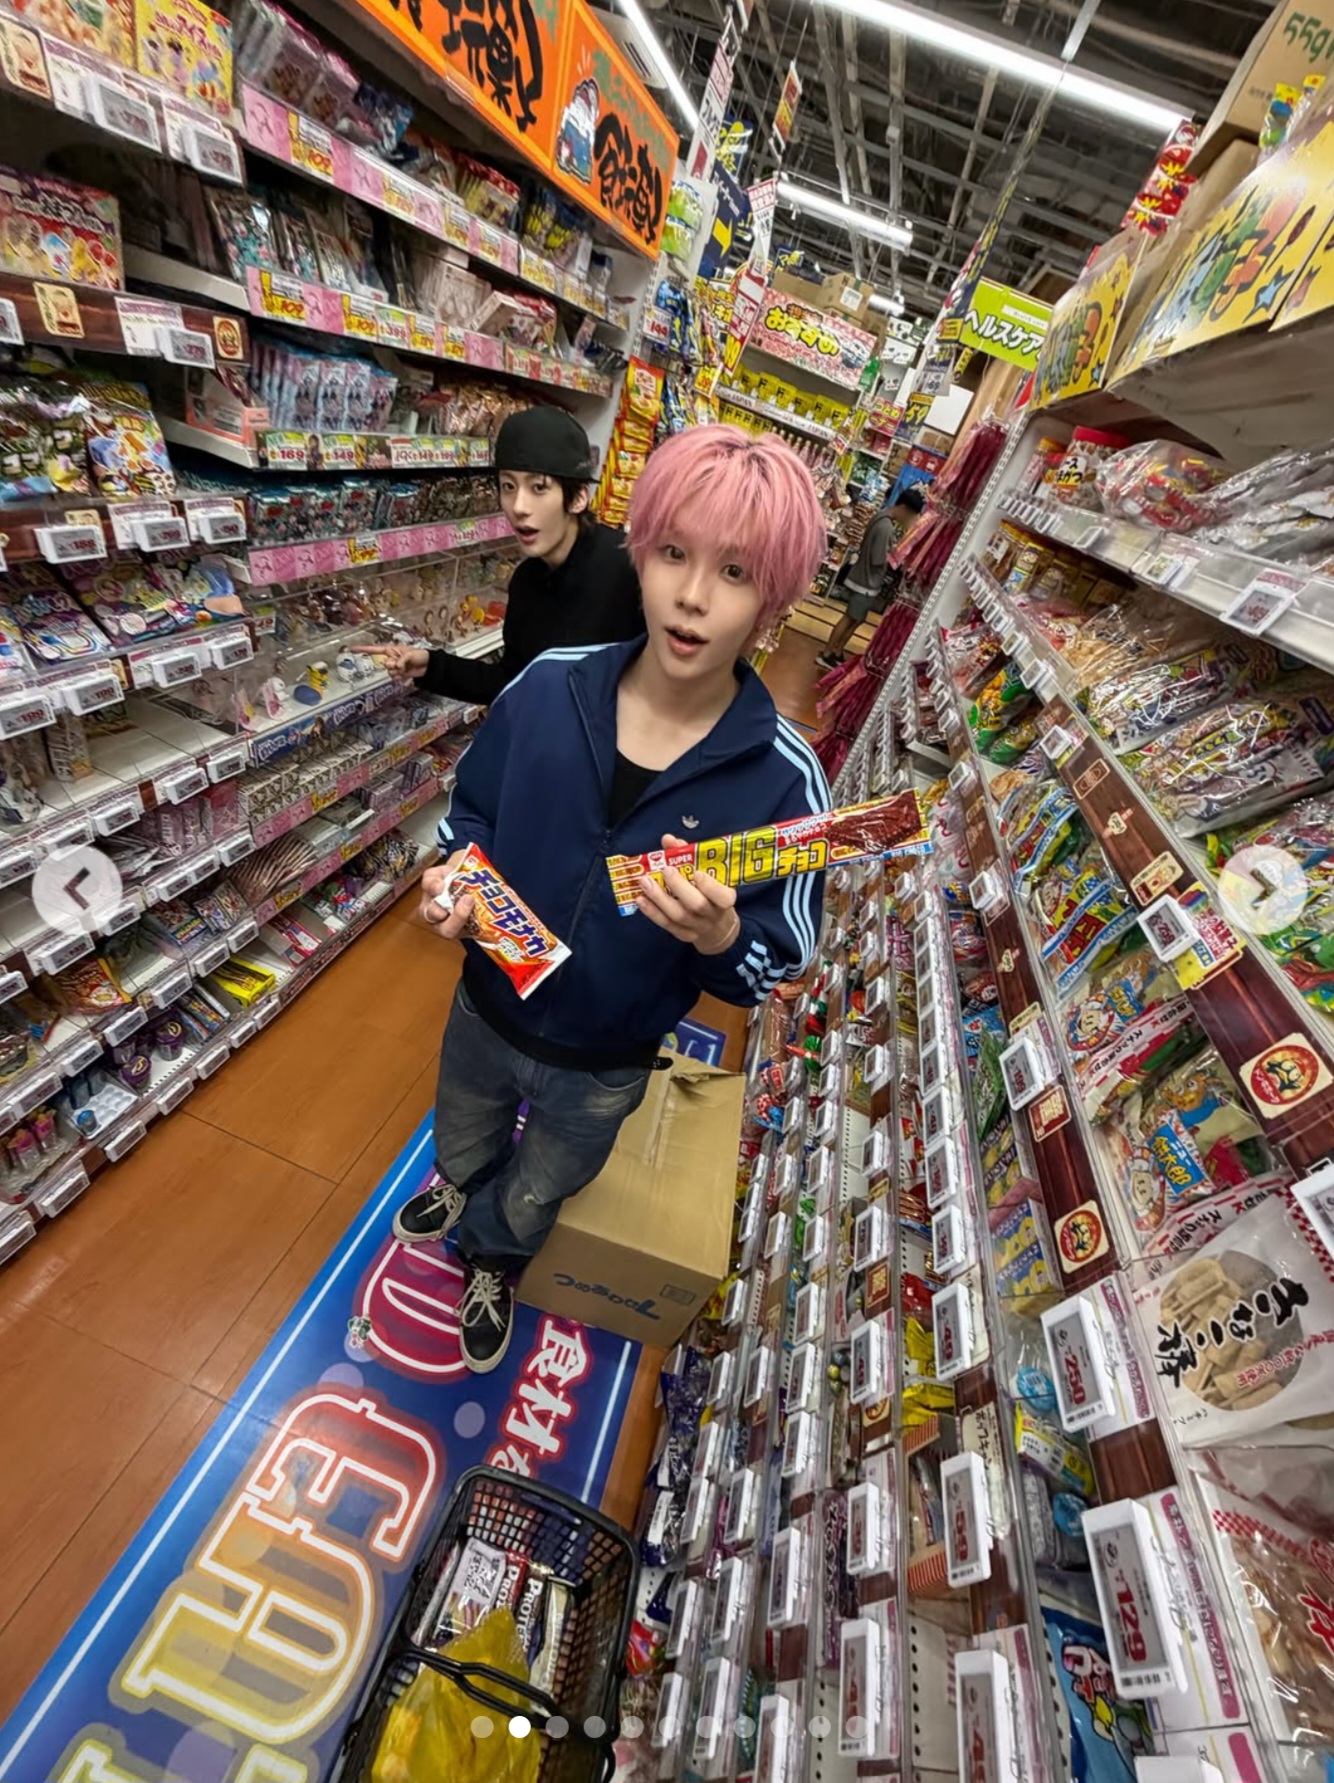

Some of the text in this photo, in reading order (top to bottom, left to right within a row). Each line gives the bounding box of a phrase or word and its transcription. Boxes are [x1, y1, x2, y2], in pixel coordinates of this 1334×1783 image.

[280, 299, 304, 314] 109
[965, 308, 1045, 357] ヘルスケア
[668, 853, 694, 867] SUPER
[696, 826, 777, 888] BIG
[776, 838, 829, 878] チョコ
[459, 868, 550, 957] チョコモナカ
[1063, 1353, 1087, 1406] 250
[1117, 1585, 1147, 1663] 129
